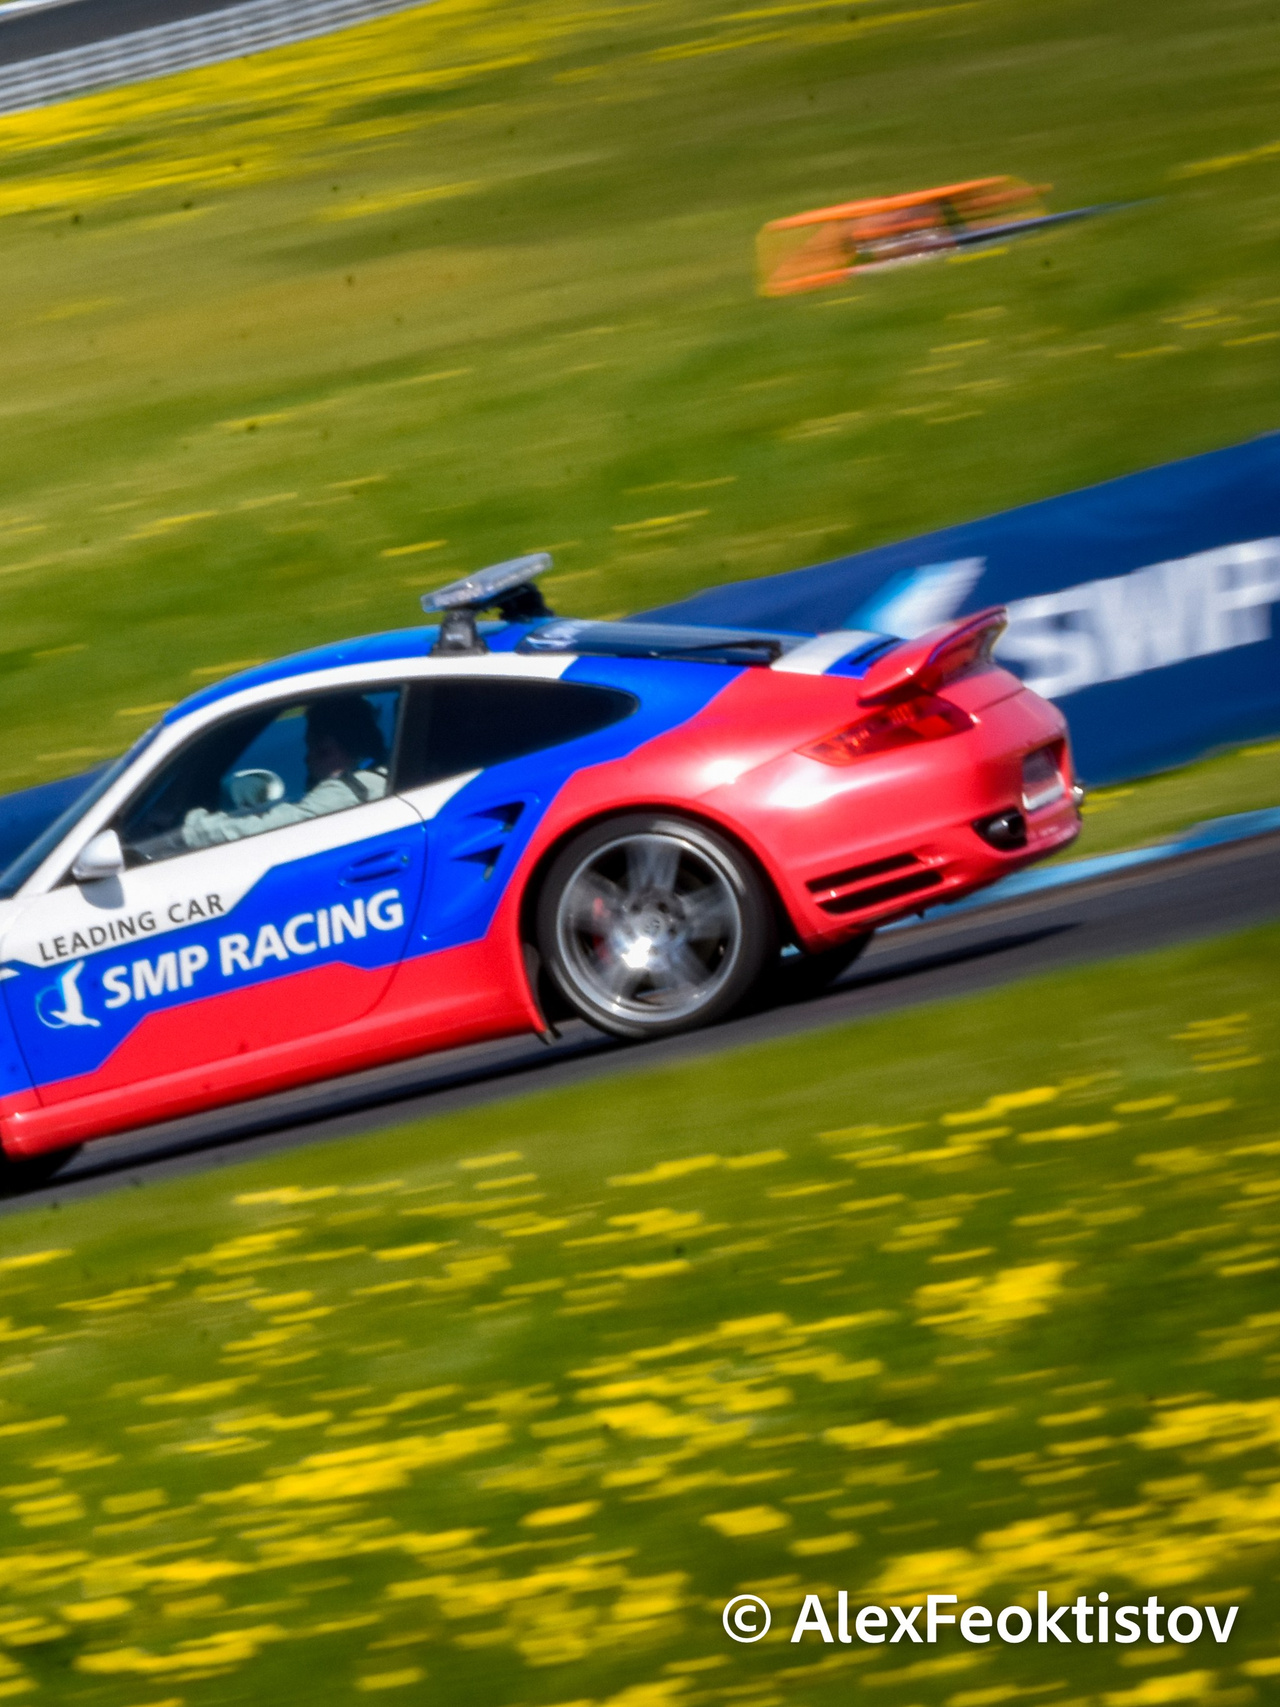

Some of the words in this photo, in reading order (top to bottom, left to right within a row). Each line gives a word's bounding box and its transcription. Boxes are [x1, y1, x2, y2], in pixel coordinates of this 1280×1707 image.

[38, 911, 156, 962] LEADING
[168, 893, 224, 924] CAR
[102, 945, 208, 1009] SMP
[220, 889, 404, 976] RACING
